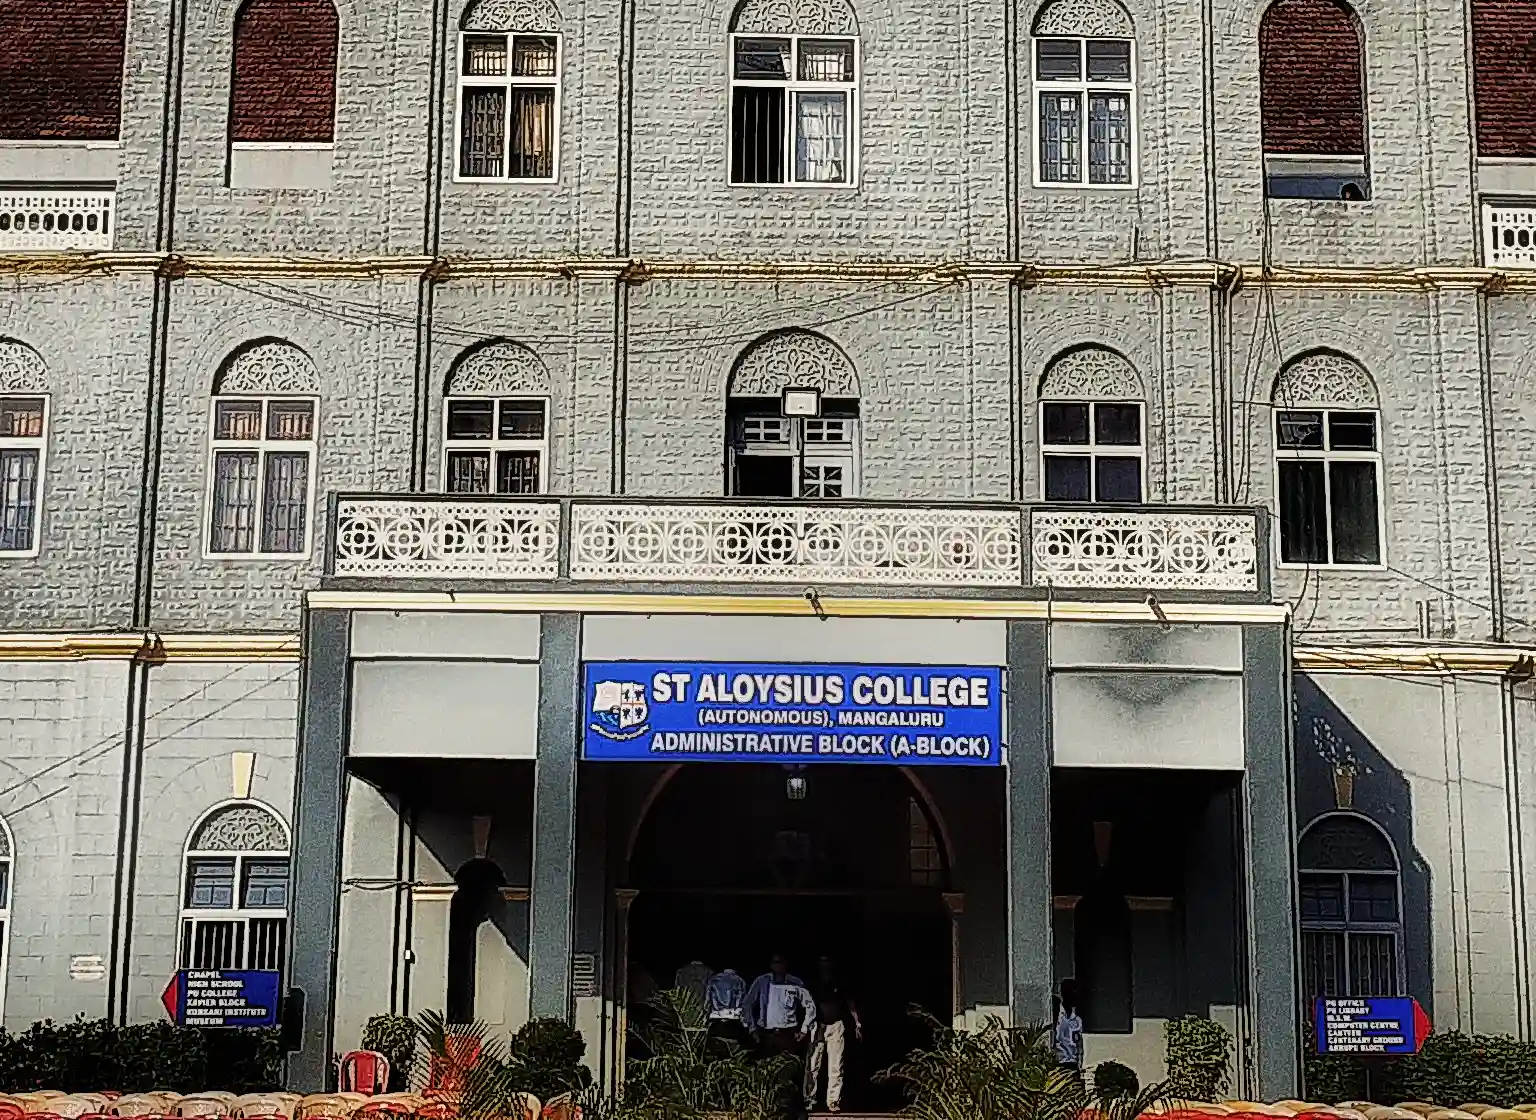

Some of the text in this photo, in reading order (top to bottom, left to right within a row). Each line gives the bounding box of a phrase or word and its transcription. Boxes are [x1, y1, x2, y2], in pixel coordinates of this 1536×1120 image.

[653, 673, 988, 705] ST ALOYSIUS COLLEGE
[699, 710, 943, 727] (AUTONOMOUS), MANGALURU
[651, 732, 989, 758] ADMINISTRATIVE BLOCK (A-BLOCK)
